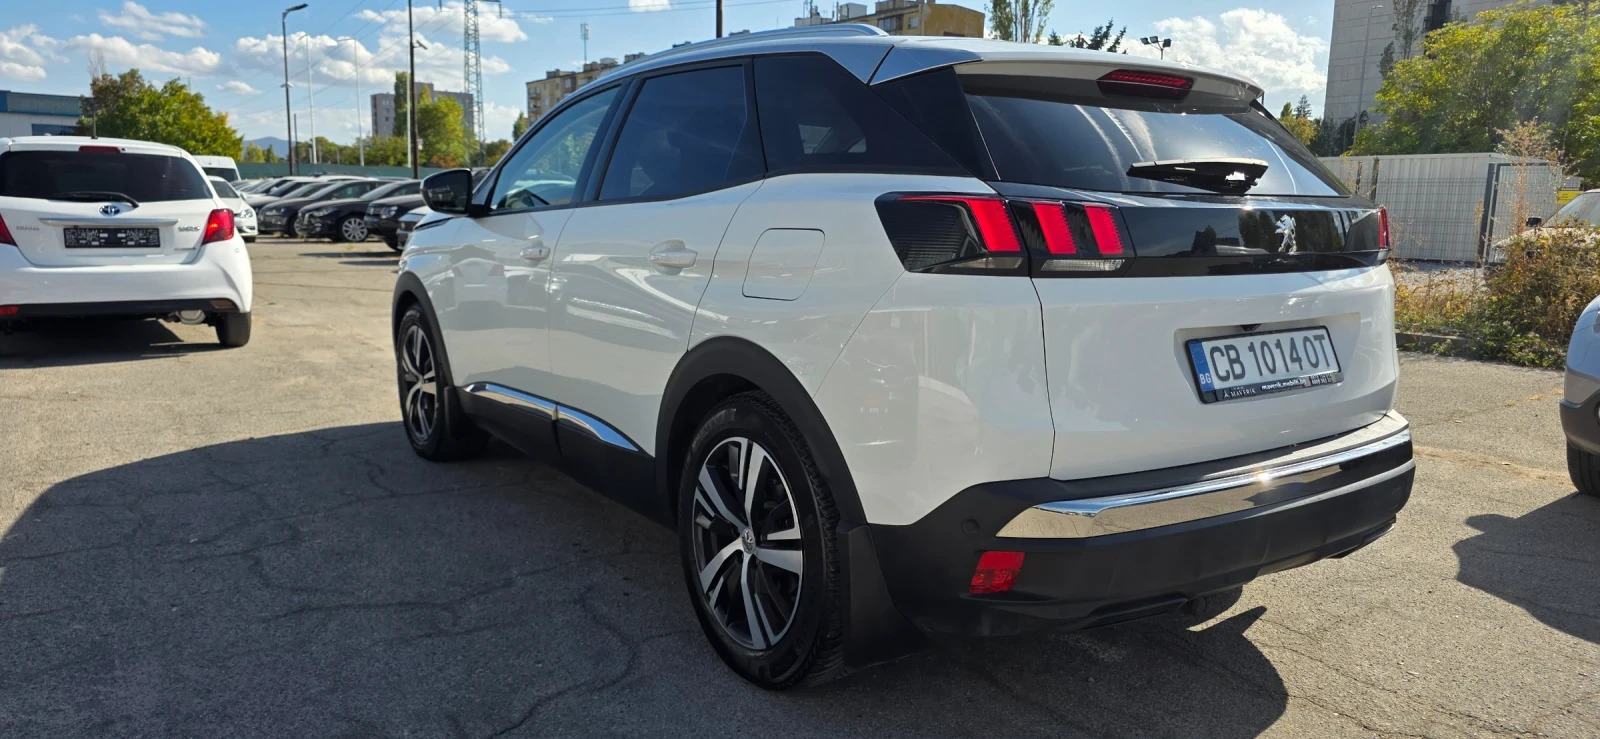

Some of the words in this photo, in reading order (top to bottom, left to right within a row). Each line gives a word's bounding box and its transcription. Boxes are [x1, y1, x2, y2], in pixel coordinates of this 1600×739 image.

[1210, 344, 1246, 381] CB
[1248, 337, 1303, 376] 1014
[1303, 334, 1331, 369] OT
[1199, 373, 1211, 385] BG
[1230, 388, 1257, 398] MAVERIK
